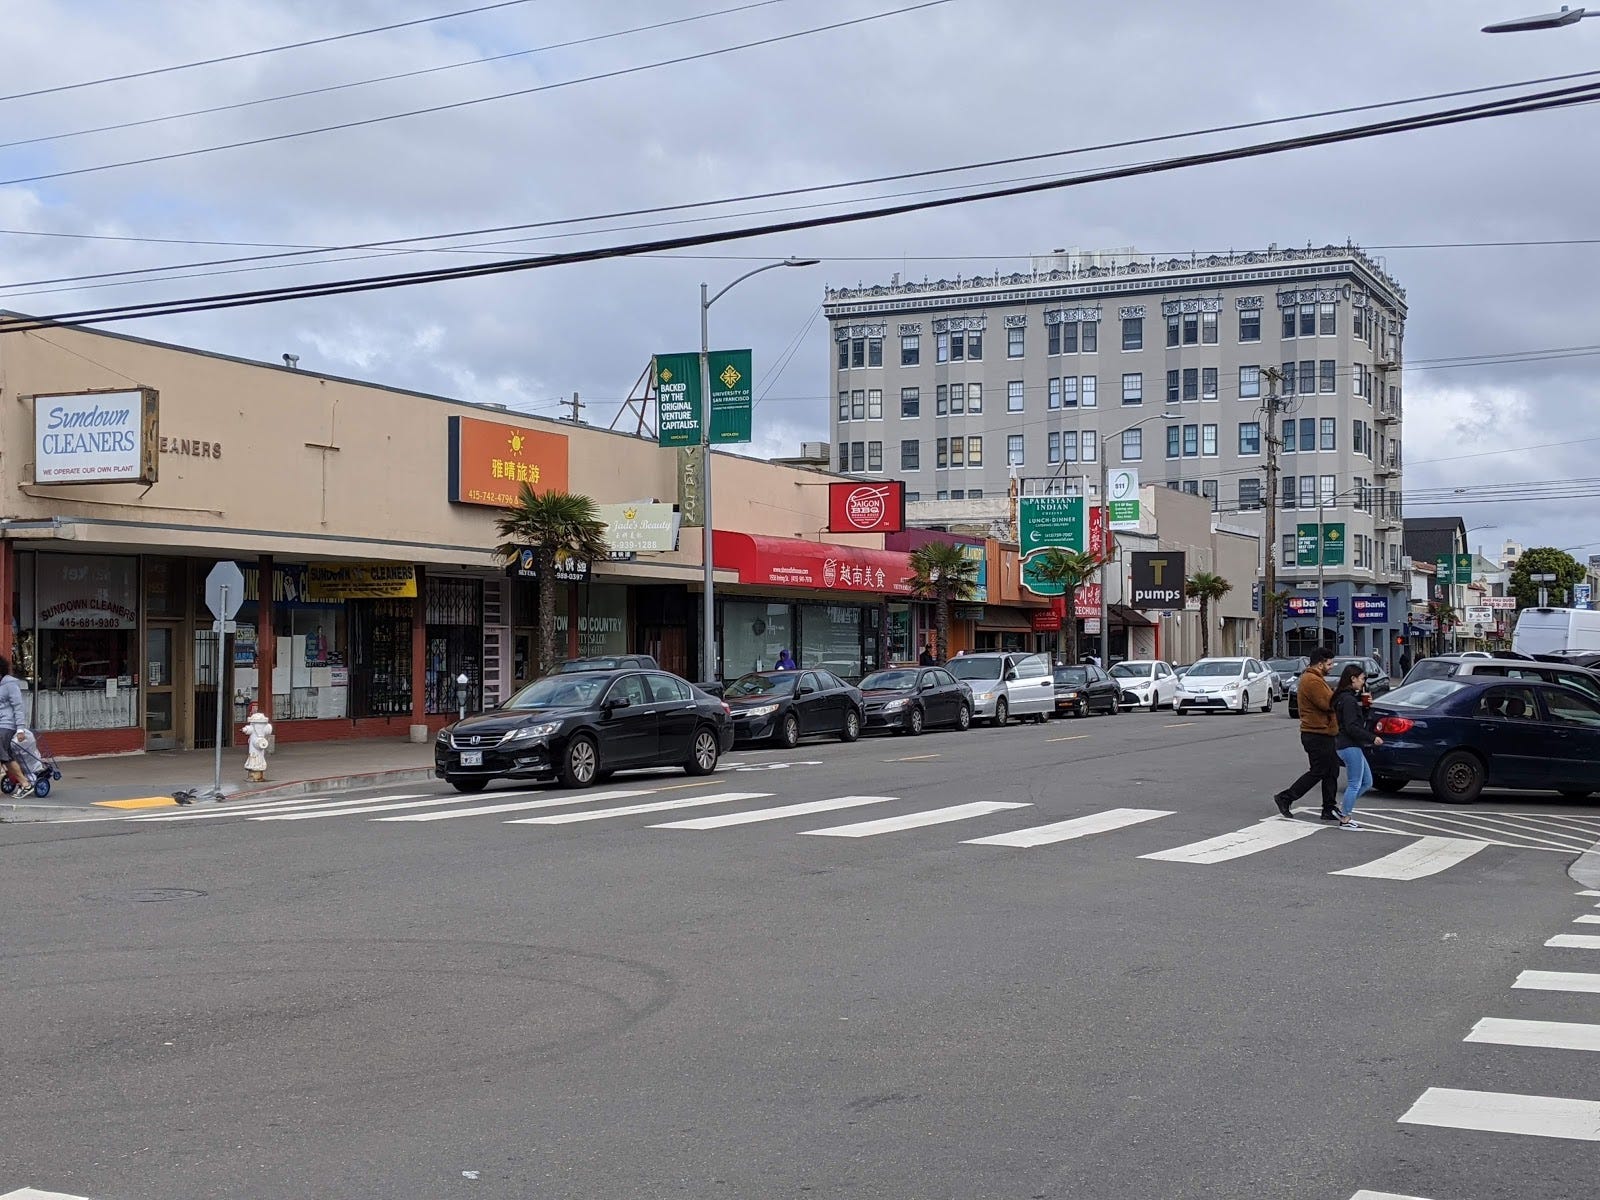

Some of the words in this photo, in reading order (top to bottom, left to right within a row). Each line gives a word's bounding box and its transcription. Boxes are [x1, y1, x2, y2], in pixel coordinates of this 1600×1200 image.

[660, 383, 686, 393] BACKED
[661, 393, 670, 402] BY
[671, 392, 684, 401] THE
[661, 402, 693, 412] ORIGINAL
[48, 405, 130, 429] Sundown
[661, 411, 692, 421] VENTURE
[661, 420, 700, 430] CAPITALIST.
[42, 430, 135, 455] CLEANERS
[160, 436, 222, 460] EANERS
[43, 468, 53, 476] WE
[53, 467, 80, 476] OPERATE
[113, 465, 134, 473] PLANT
[684, 463, 697, 523] SALON
[851, 495, 880, 507] SAIGON
[1029, 497, 1076, 505] PAKISTANI
[1036, 503, 1069, 511] INDIAN
[613, 519, 638, 531] Jade's
[640, 519, 672, 531] Beauty
[555, 572, 584, 580] -988-0397
[840, 561, 886, 589] 越南美食
[1149, 560, 1168, 585] T
[1135, 588, 1181, 602] pumps
[1289, 598, 1328, 608] usbak
[1354, 600, 1386, 608] usbank
[41, 600, 88, 622] SUNDOWN
[90, 599, 136, 622] CLEANERS
[1074, 606, 1097, 616] ZECHUAN
[553, 615, 569, 631] TOW
[577, 616, 587, 631] ND
[589, 616, 622, 632] COUNTRY
